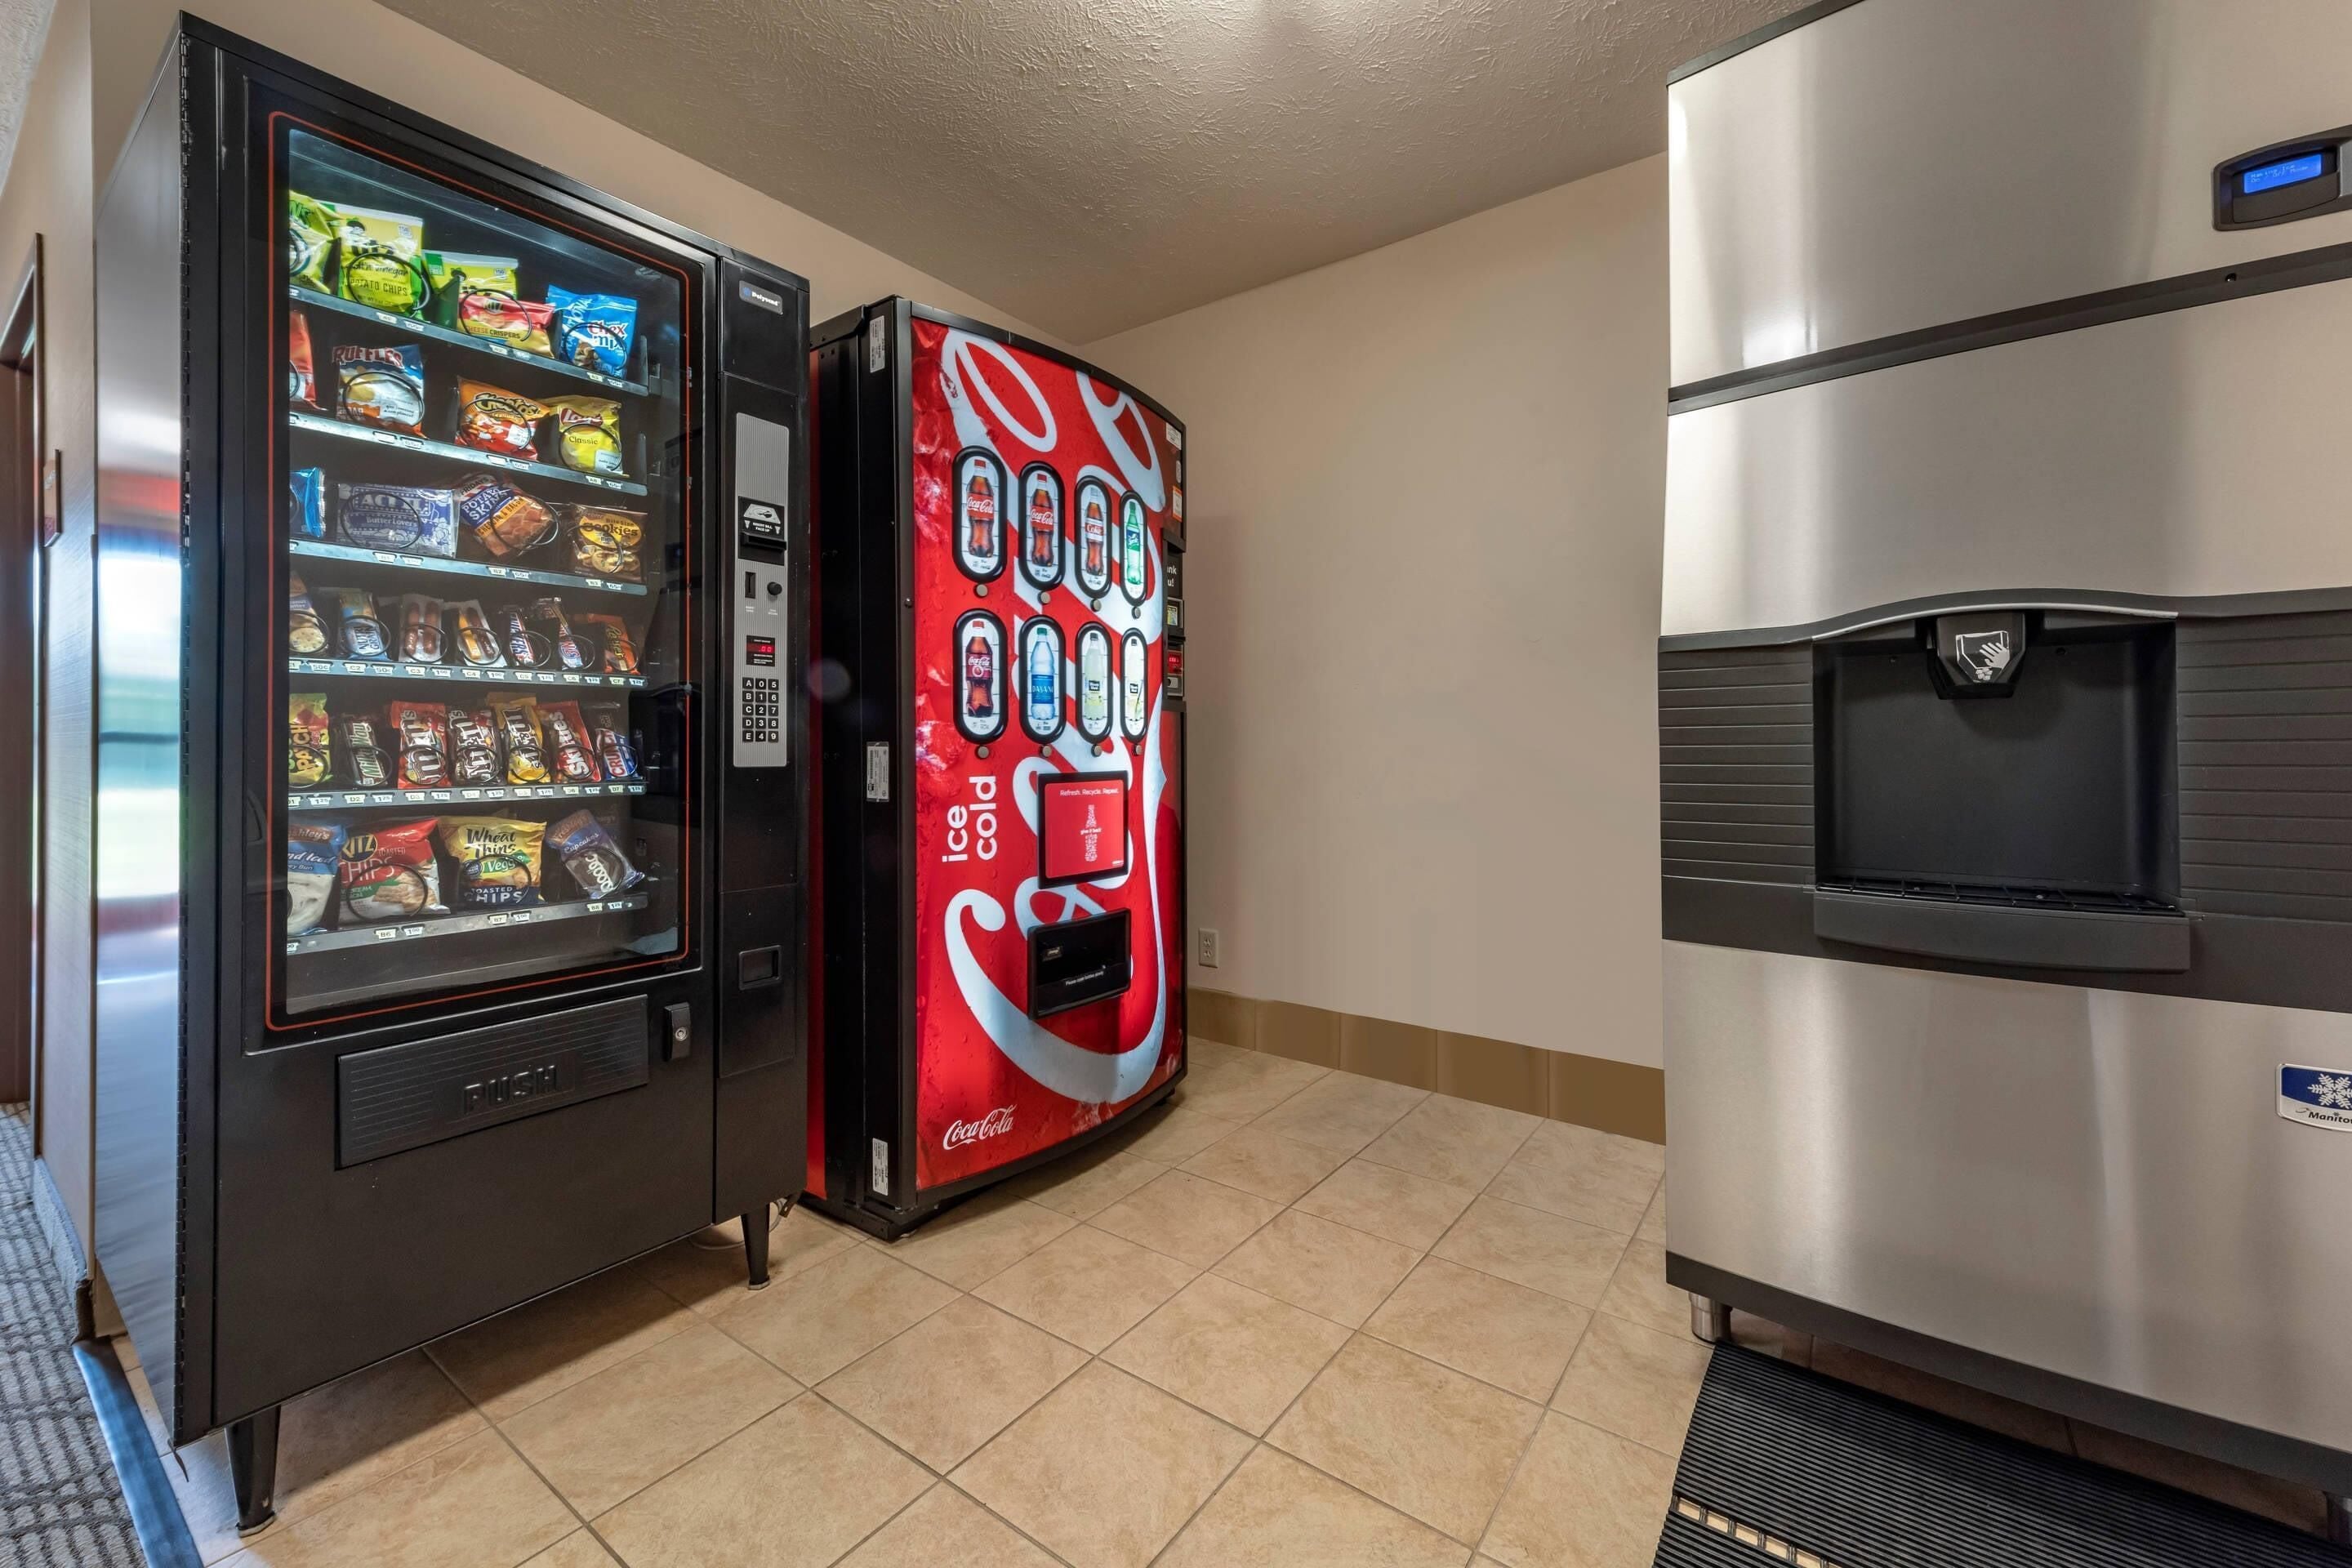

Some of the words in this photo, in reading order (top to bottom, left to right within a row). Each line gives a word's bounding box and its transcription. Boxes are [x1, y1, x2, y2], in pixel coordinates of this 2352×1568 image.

[382, 283, 409, 296] CHIPS
[489, 329, 521, 340] CRISPERS
[568, 435, 599, 445] Classic
[461, 487, 501, 514] POTATO
[966, 496, 994, 514] Coca-Cola
[367, 515, 391, 525] Butter
[1031, 508, 1054, 526] Coca-Cola
[582, 522, 639, 537] Cookies
[969, 776, 997, 861] cold
[466, 826, 516, 844] Wheat
[942, 805, 968, 862] ice
[564, 832, 600, 854] Cupcakes
[378, 847, 406, 857] TOASTED
[463, 844, 517, 860] Thins
[464, 891, 523, 904] CHIPS
[463, 1064, 557, 1116] PUSH
[2308, 1111, 2352, 1125] Manito
[942, 1104, 1018, 1151] Coca-Cola
